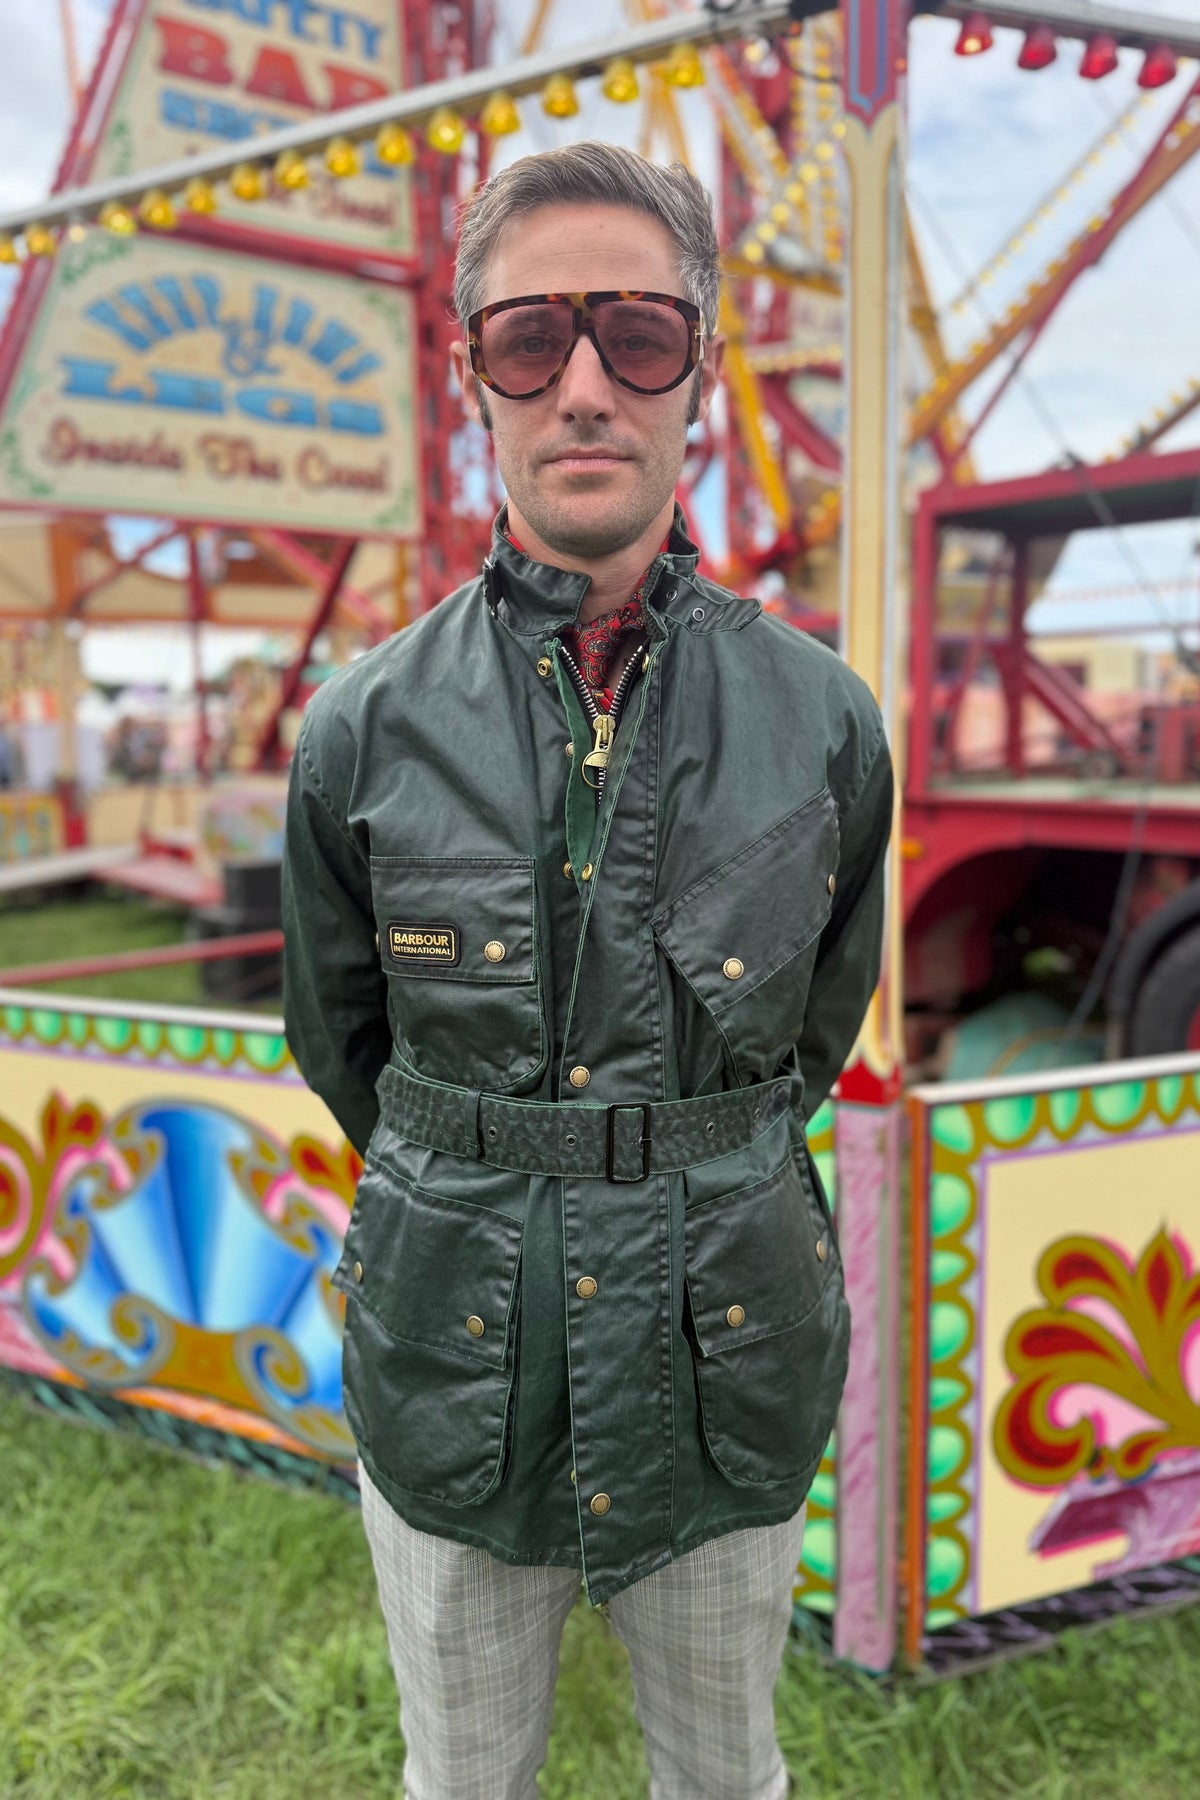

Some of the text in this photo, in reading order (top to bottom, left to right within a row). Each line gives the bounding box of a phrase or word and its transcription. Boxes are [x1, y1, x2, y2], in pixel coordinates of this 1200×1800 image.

[183, 0, 384, 60] AFETY
[60, 355, 386, 437] LEGS
[393, 945, 451, 956] INTERNATIONAL
[394, 932, 449, 946] BARBOUR
